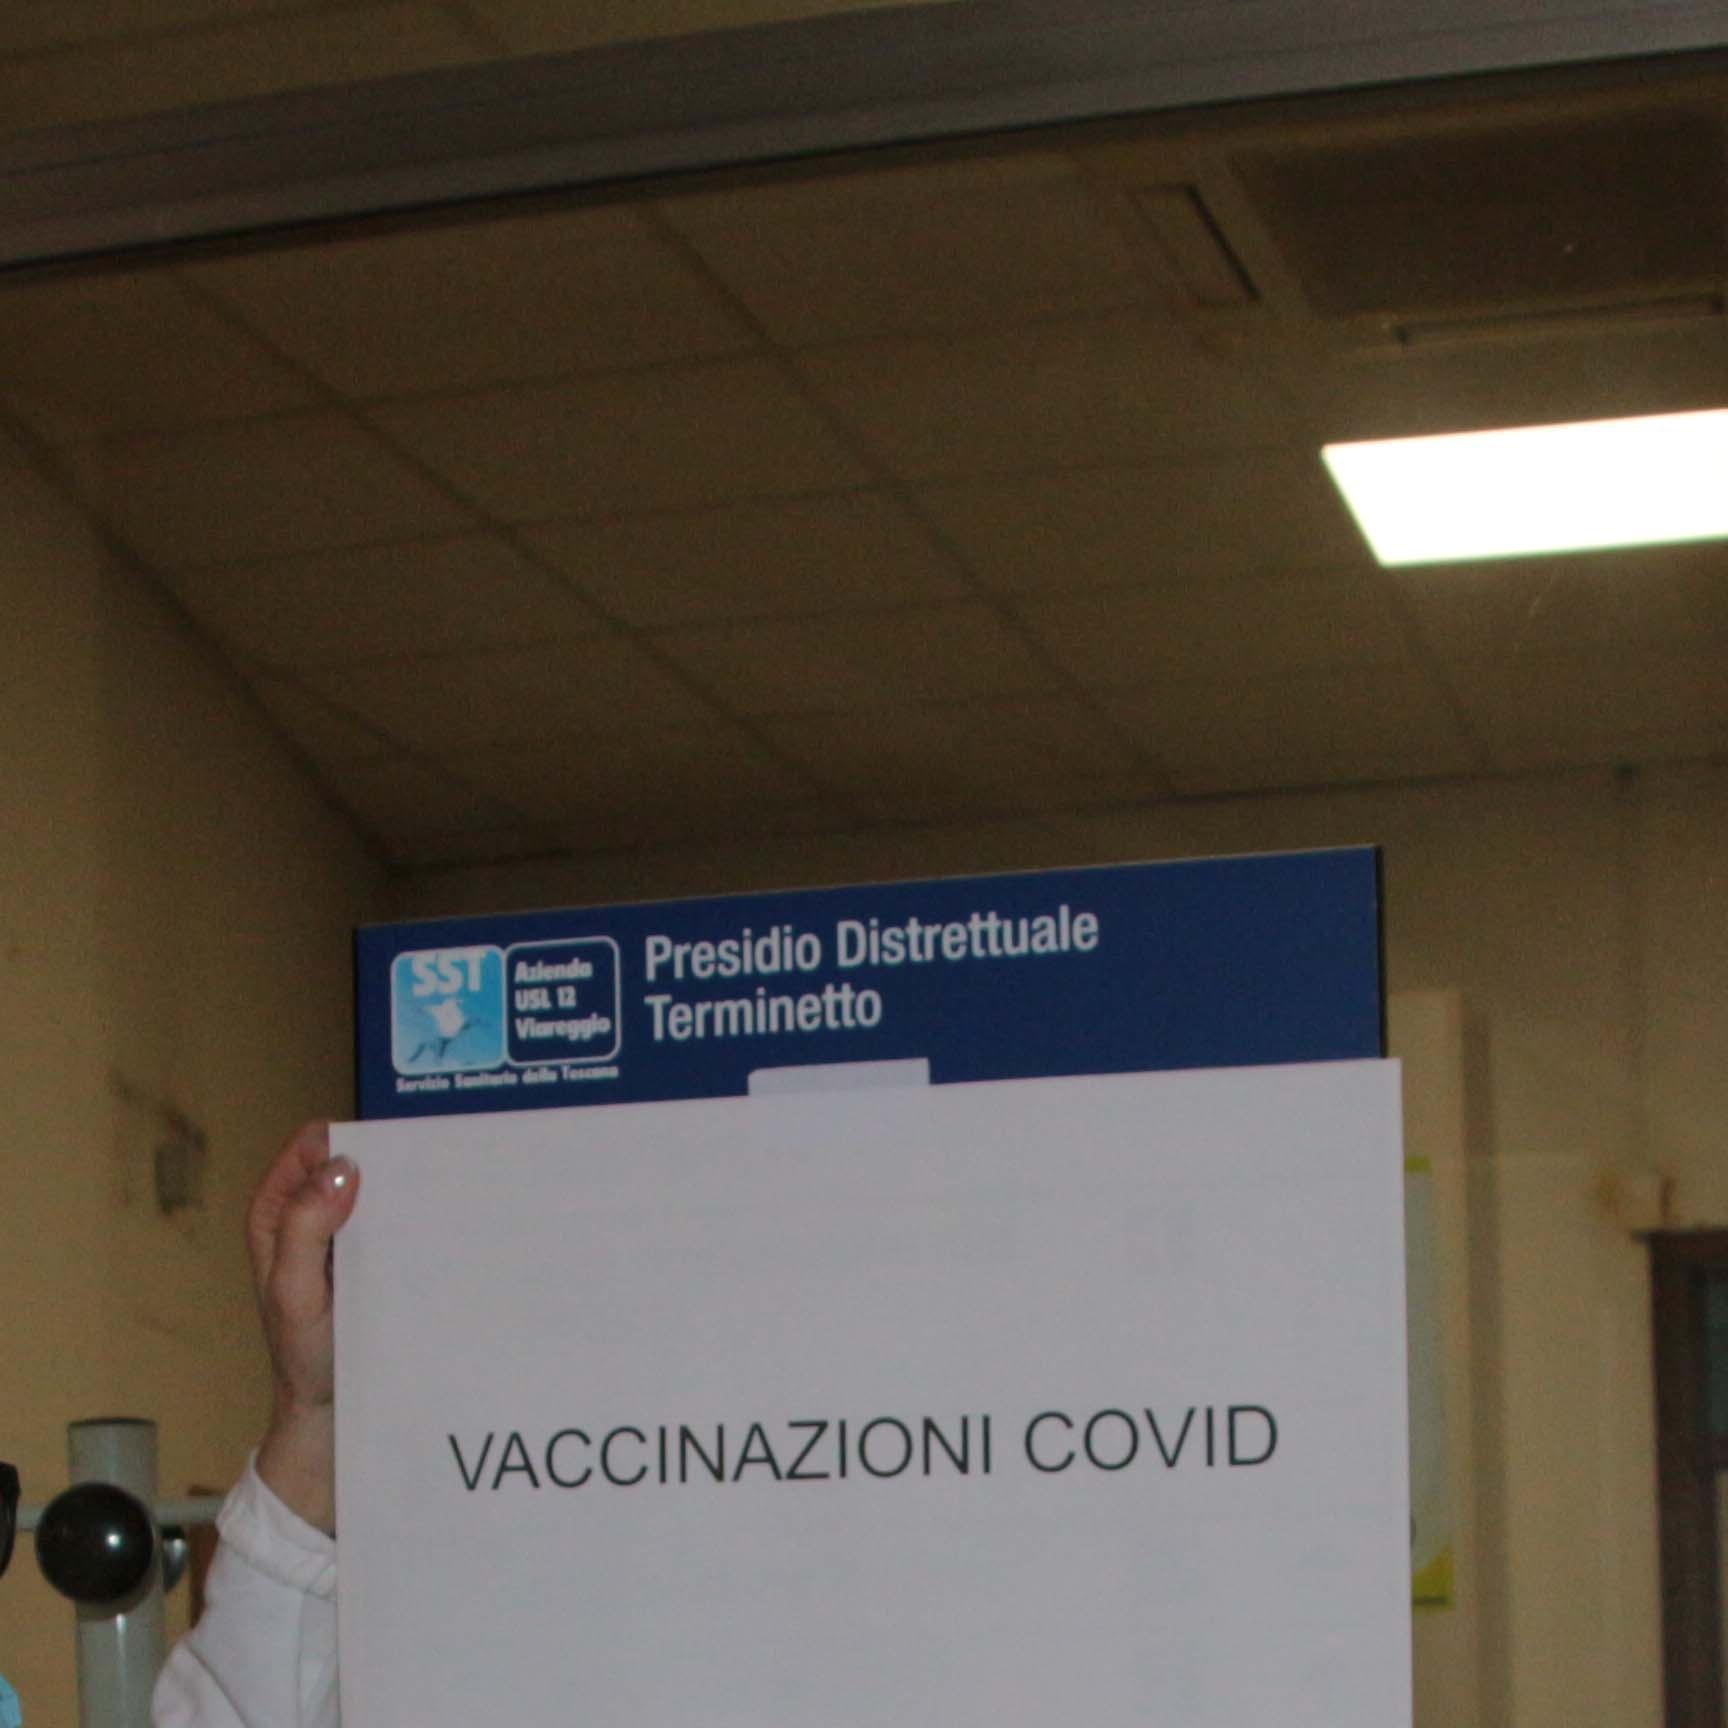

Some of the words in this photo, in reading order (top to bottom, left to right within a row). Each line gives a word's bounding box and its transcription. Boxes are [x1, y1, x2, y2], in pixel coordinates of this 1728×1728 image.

[644, 923, 822, 982] Presidio
[837, 904, 1099, 968] Distrettuale
[412, 948, 486, 997] SST
[513, 957, 594, 983] Azienda
[514, 1012, 612, 1042] Viareggio
[644, 983, 883, 1041] Terminetto
[449, 1414, 994, 1494] VACCINAZIONI
[1022, 1403, 1280, 1476] COVID
